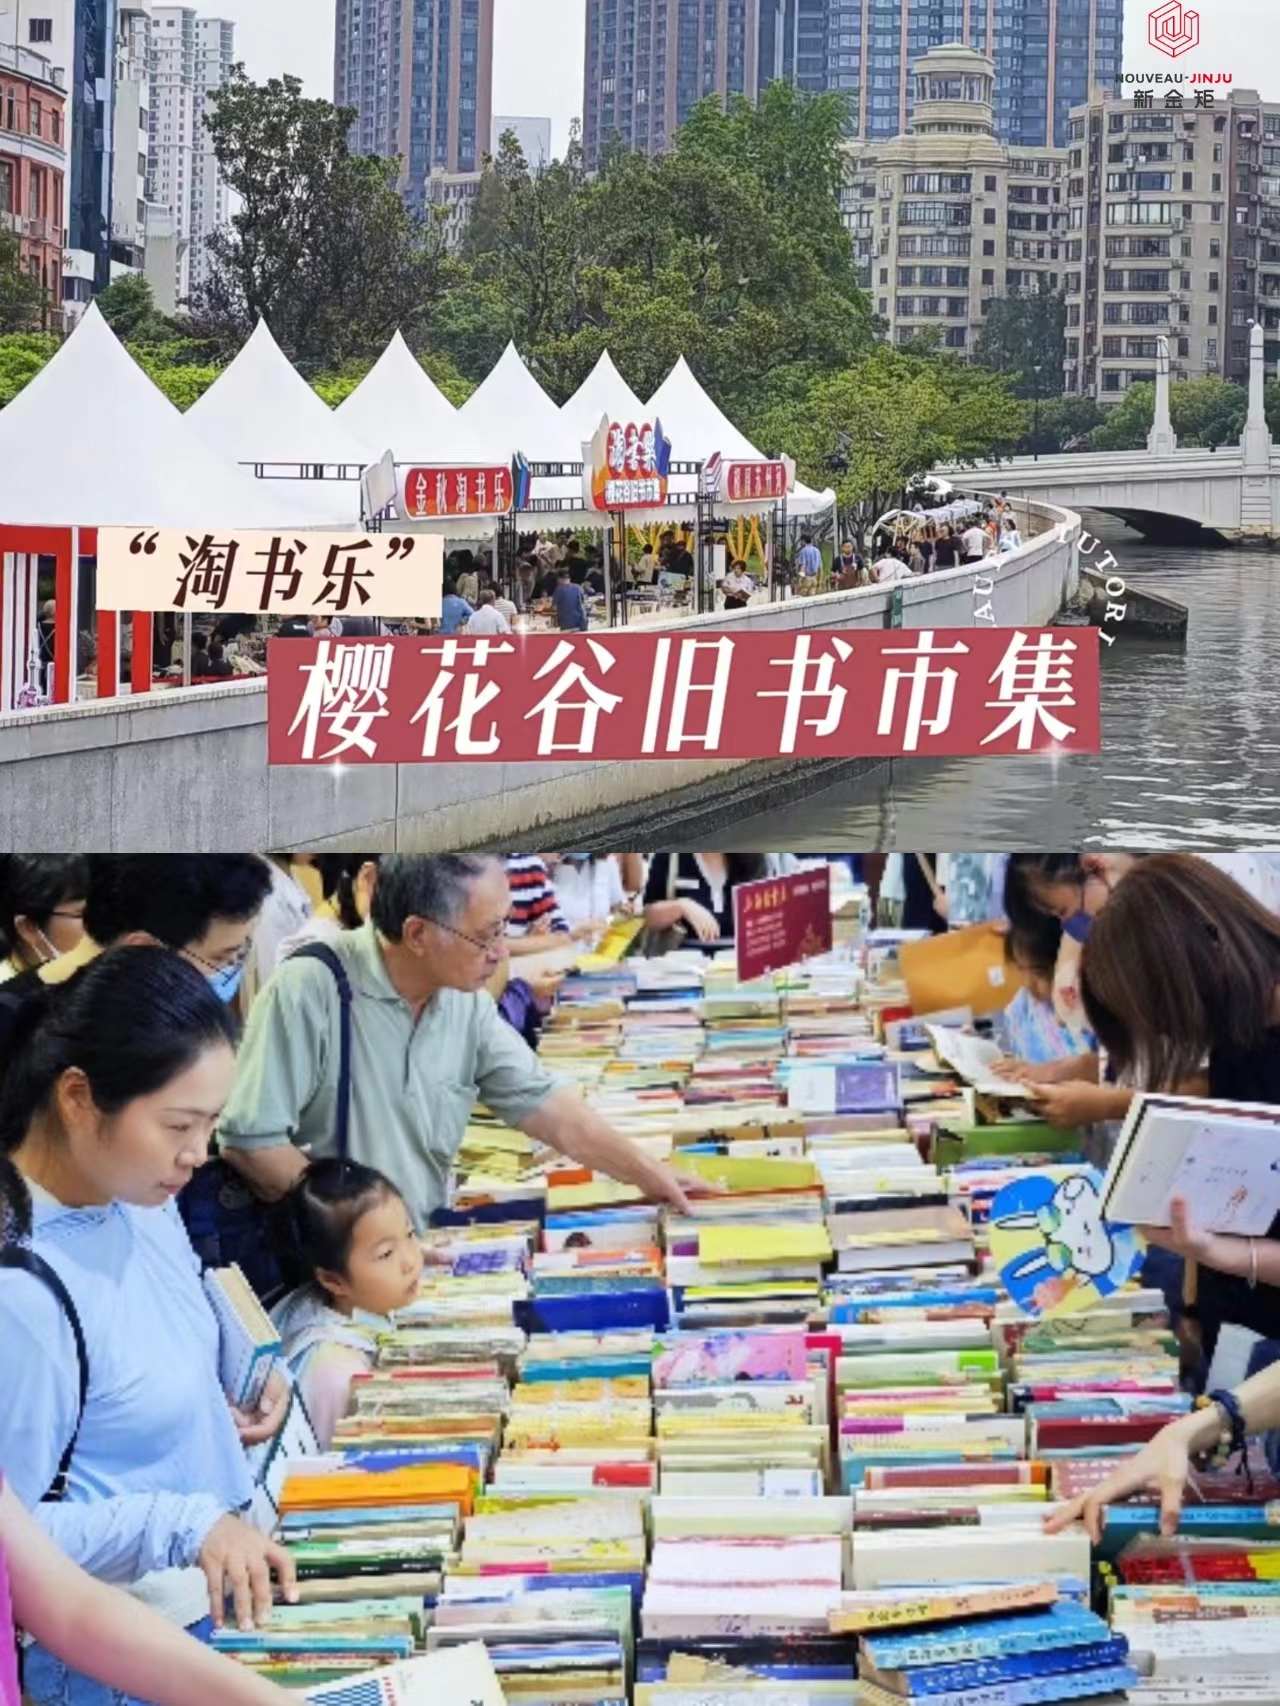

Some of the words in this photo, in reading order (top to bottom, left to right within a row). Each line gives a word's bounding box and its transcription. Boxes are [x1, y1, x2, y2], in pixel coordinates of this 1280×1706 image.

[415, 471, 505, 515] 金秋淘书乐
